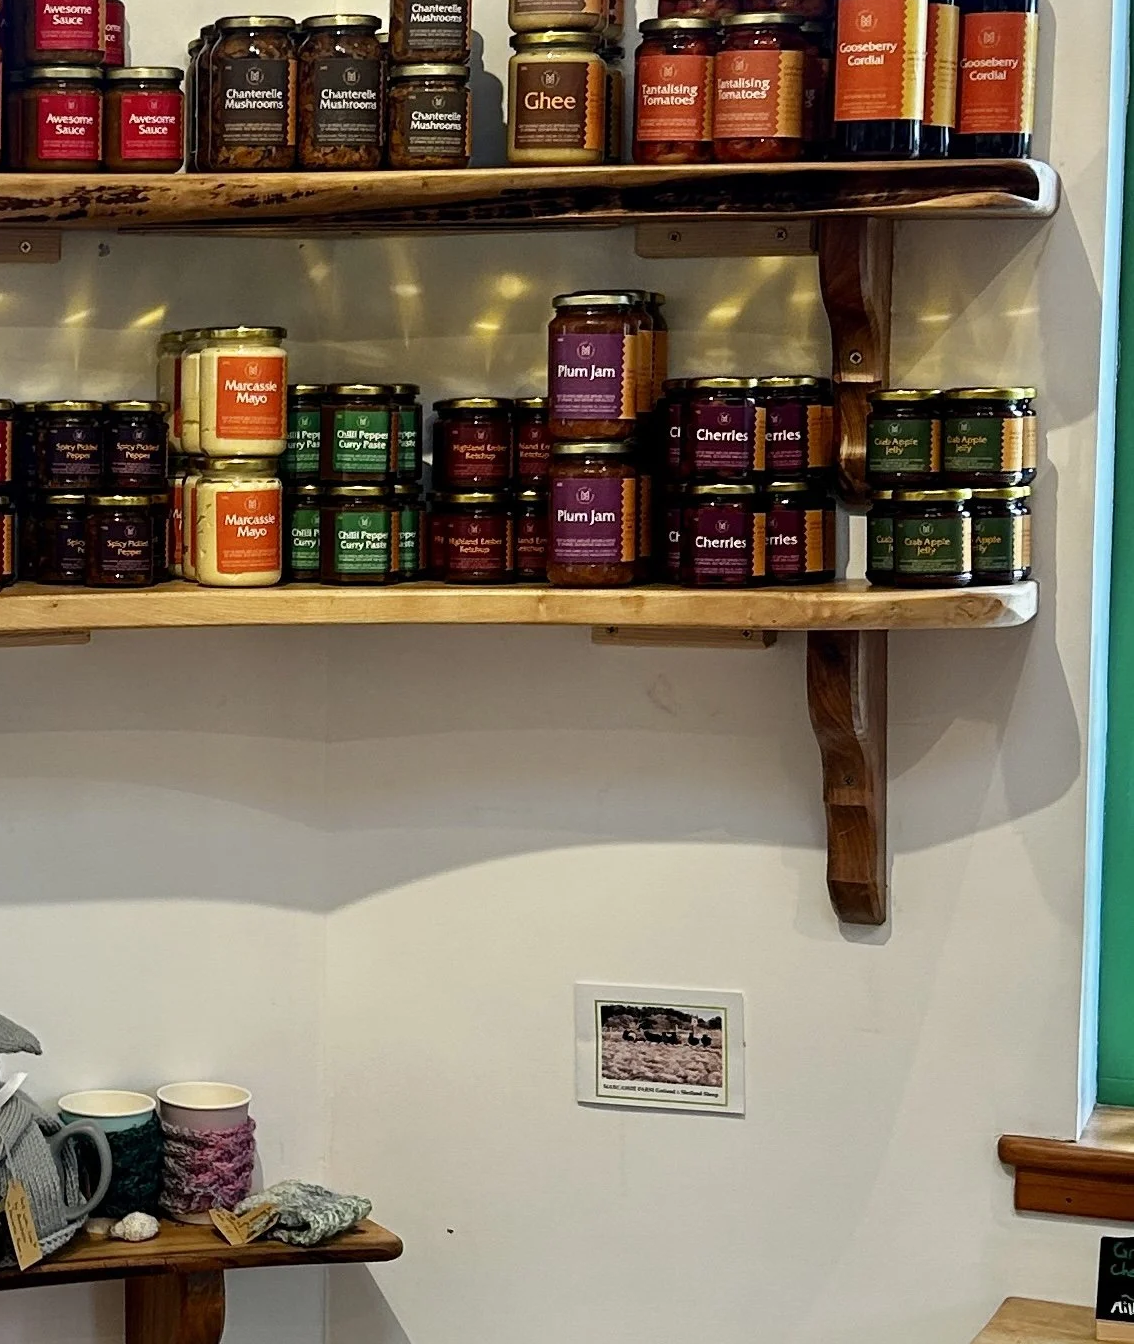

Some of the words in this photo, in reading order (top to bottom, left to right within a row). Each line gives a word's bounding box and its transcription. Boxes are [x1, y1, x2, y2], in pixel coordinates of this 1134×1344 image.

[43, 4, 92, 15] Awesome
[411, 3, 462, 14] Chanterelle
[52, 14, 83, 26] Sauce
[410, 13, 463, 24] Mushrooms
[839, 41, 898, 55] Gooseberry
[847, 55, 884, 67] Cordial
[960, 57, 1018, 69] Gooseberry
[969, 70, 1007, 81] Cordial
[641, 83, 698, 97] Tantalising
[717, 78, 771, 91] Tantalising
[226, 88, 283, 100] Chanterelle
[321, 89, 376, 100] Chanterelle
[642, 94, 695, 106] Tomatoes
[717, 88, 767, 101] Tomatoes
[224, 98, 284, 110] Mushrooms
[319, 99, 377, 110] Mushrooms
[524, 91, 577, 110] Ghee
[45, 113, 94, 125] Awesome
[128, 113, 176, 125] Awesome
[411, 111, 462, 122] Chanterelle
[55, 123, 86, 136] Sauce
[138, 123, 168, 135] Sauce
[410, 120, 462, 131] Mushrooms
[557, 364, 587, 378] Plum
[589, 364, 616, 380] Jam
[224, 379, 277, 394] Marcassie
[236, 392, 268, 406] Mayo
[337, 429, 357, 439] Chilli
[696, 428, 749, 442] Cherries
[766, 429, 801, 442] erries
[287, 440, 305, 451] urry
[338, 440, 362, 451] Curry
[362, 440, 387, 449] Paste
[891, 437, 919, 447] Apple
[961, 435, 988, 446] Apple
[885, 445, 904, 456] Jelly
[955, 444, 972, 454] Jelly
[224, 513, 276, 527] Marcassie
[557, 509, 587, 523] Plum
[589, 509, 616, 525] Jam
[236, 526, 267, 539] Mayo
[291, 528, 312, 537] Chilli
[338, 531, 360, 540] Chilli
[293, 538, 316, 548] Curry
[340, 540, 364, 550] Curry
[365, 541, 387, 549] Paste
[695, 536, 747, 550] Cherries
[923, 537, 951, 547] Apple
[917, 546, 937, 556] Jelly
